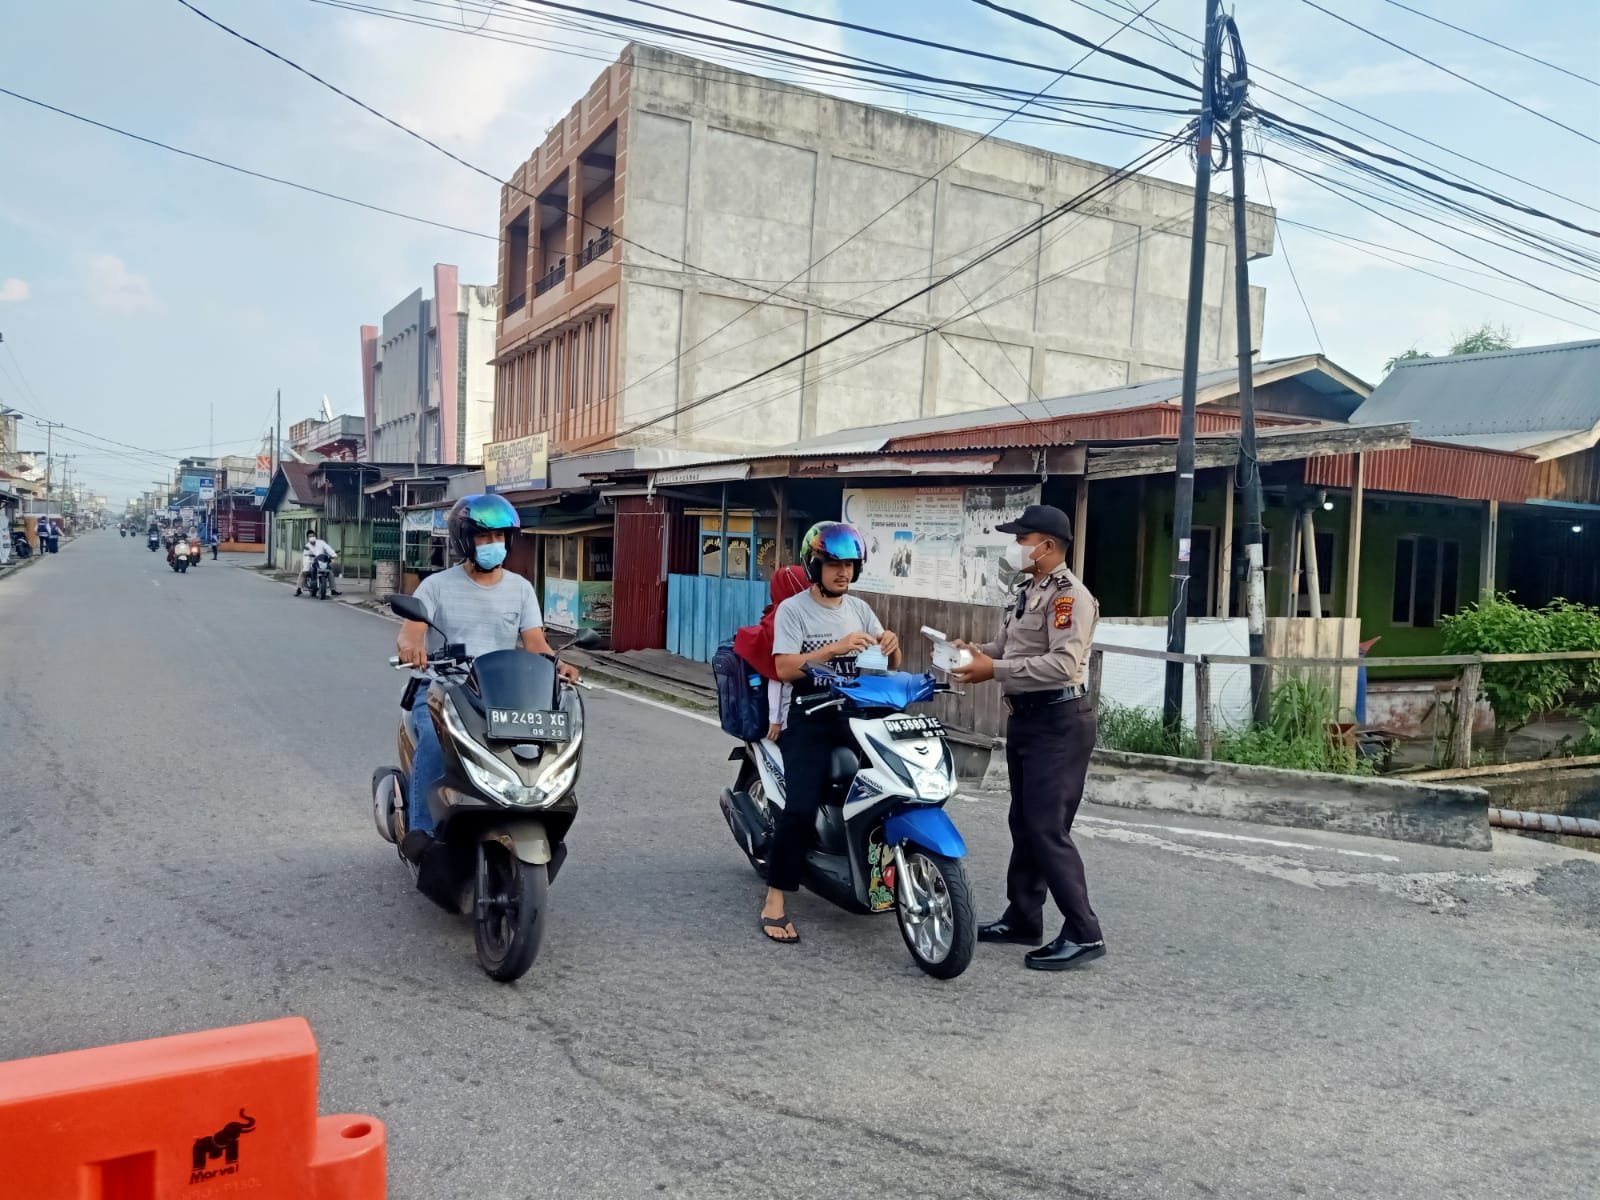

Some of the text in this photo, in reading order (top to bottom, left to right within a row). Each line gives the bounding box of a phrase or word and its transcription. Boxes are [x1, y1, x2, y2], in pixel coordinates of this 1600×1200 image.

[492, 710, 565, 726] BM 2483 XG
[885, 721, 902, 732] BM
[925, 717, 941, 728] XE
[861, 774, 884, 791] HONDA
